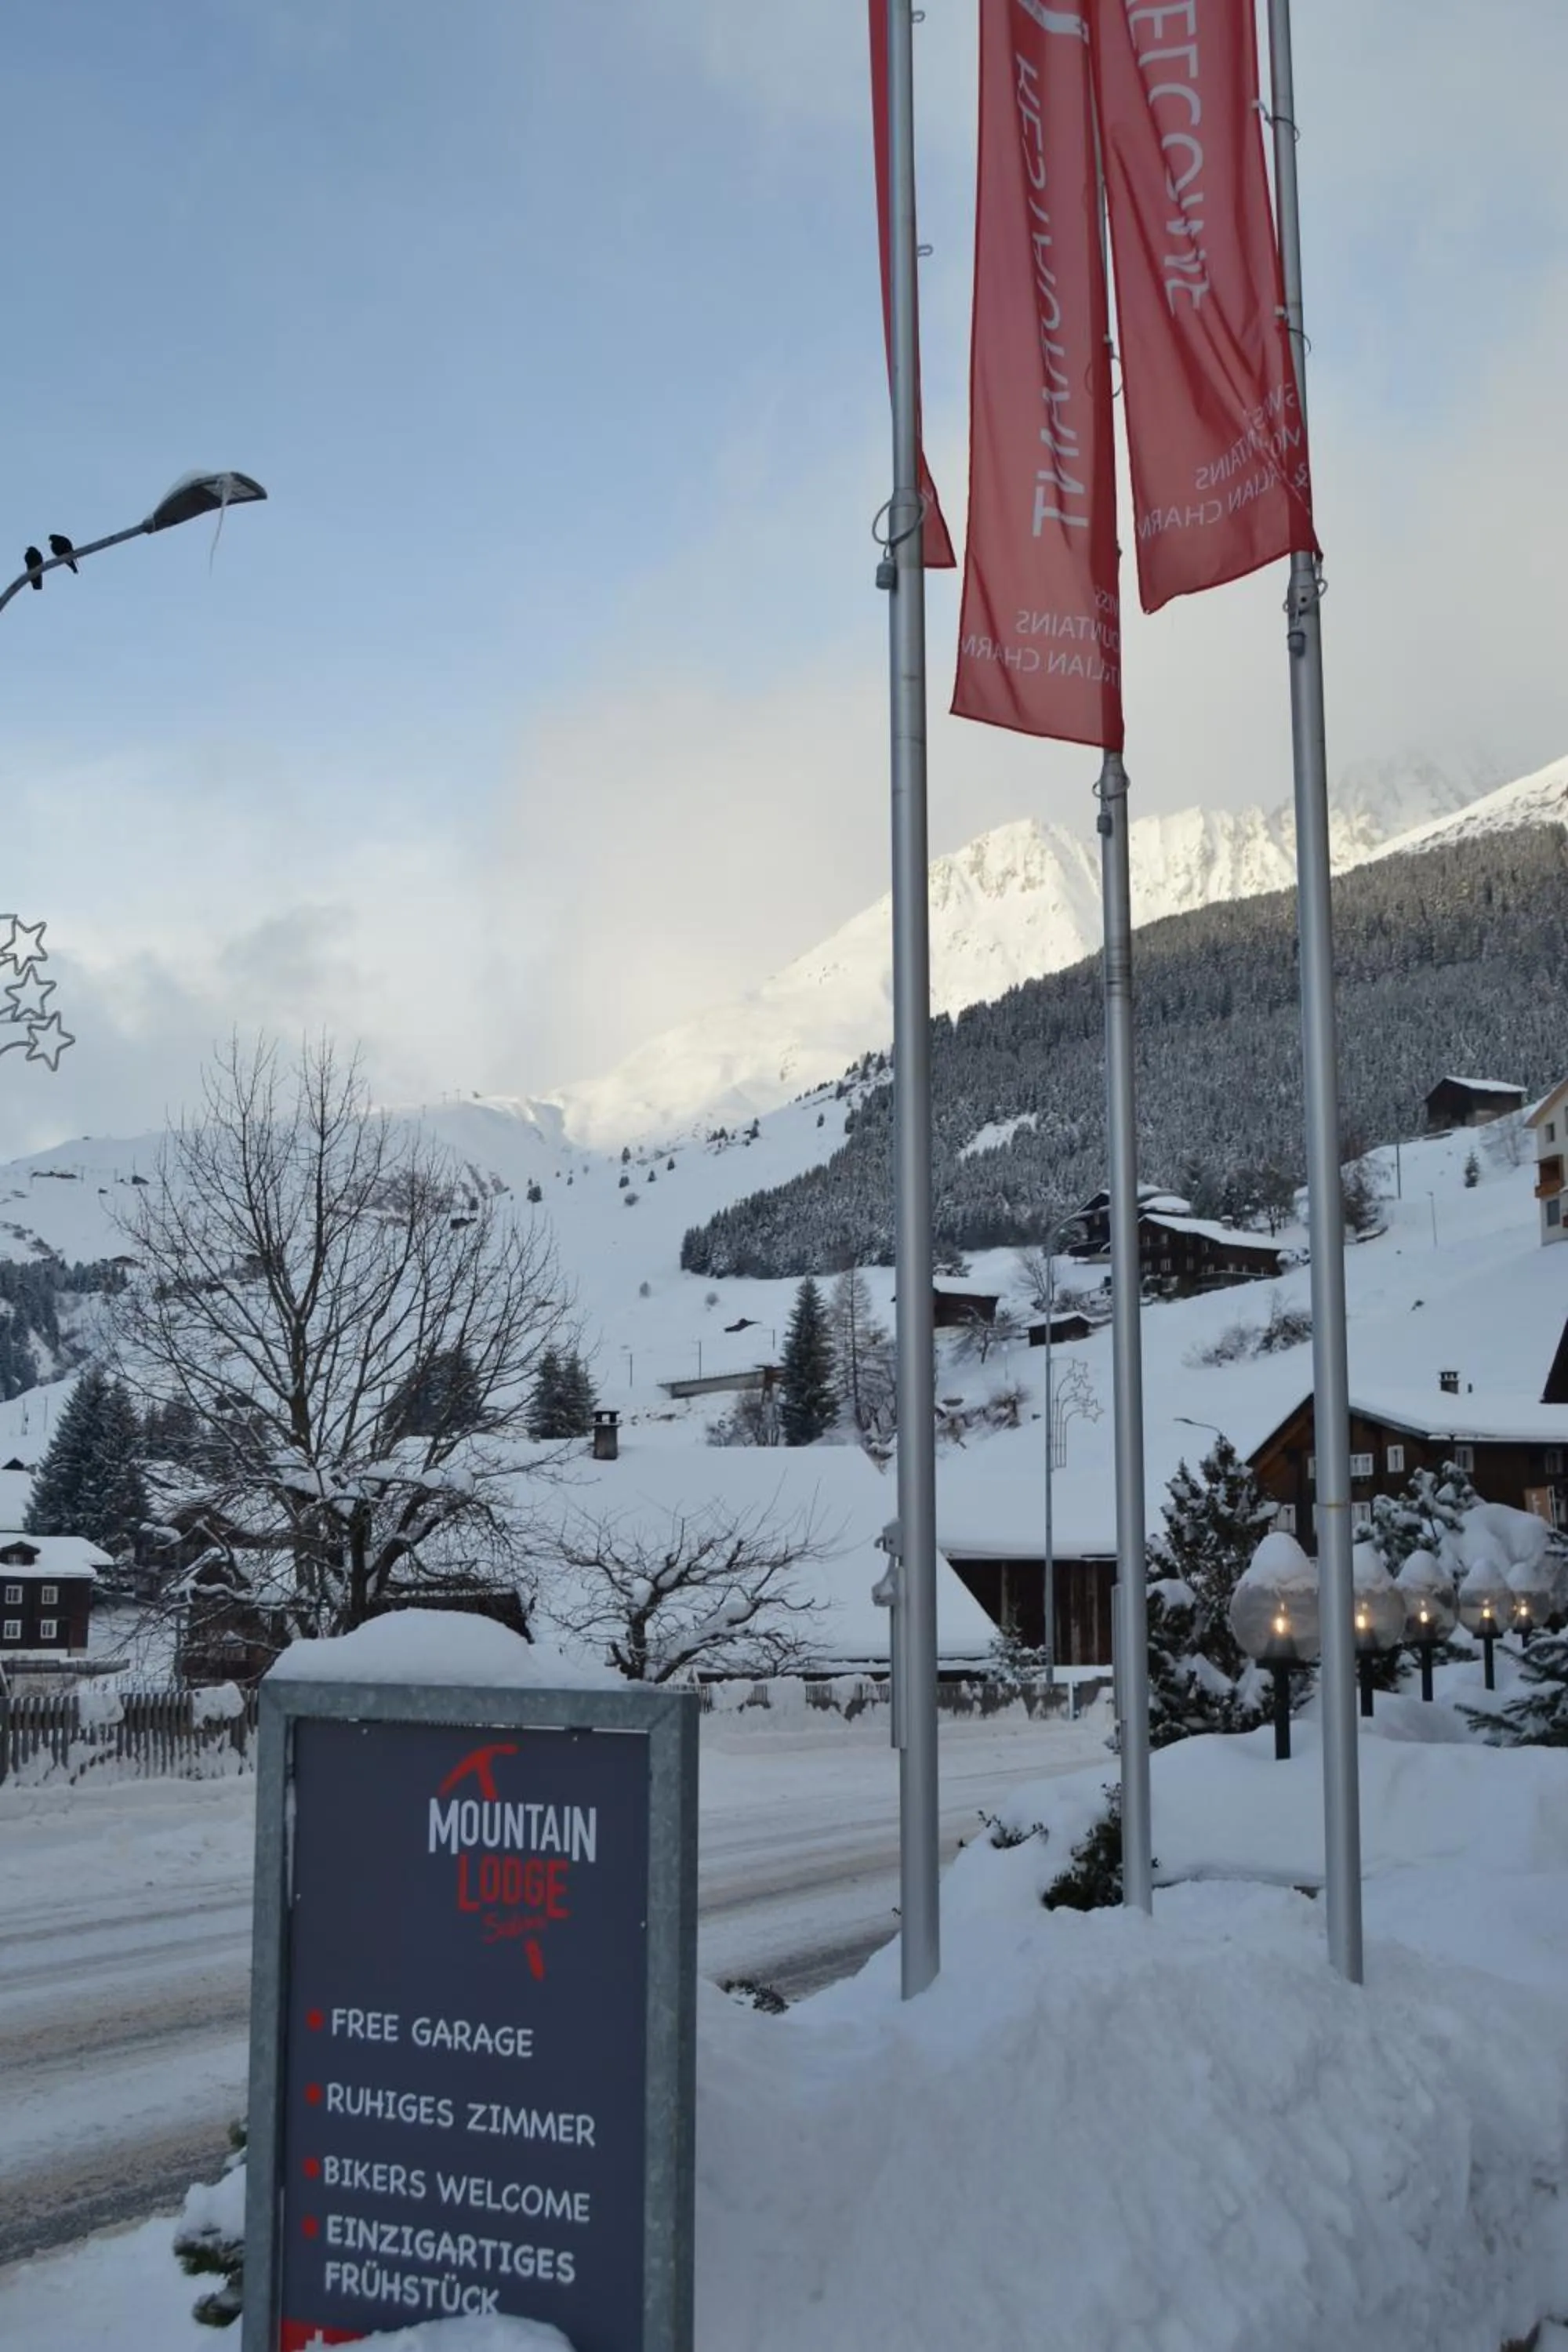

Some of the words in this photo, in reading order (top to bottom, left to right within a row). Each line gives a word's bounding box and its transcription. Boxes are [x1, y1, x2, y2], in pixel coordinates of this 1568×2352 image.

[428, 1797, 597, 1864] MOUNTAIN
[457, 1852, 571, 1919] LODGE
[331, 2008, 399, 2042] FREE
[411, 2017, 533, 2057] GARAGE
[325, 2082, 455, 2128] RUHIGES
[466, 2103, 596, 2148] ZIMMER
[323, 2155, 427, 2198] BIKERS
[436, 2172, 590, 2223] WELCOME
[325, 2214, 576, 2284] EINZIGARTIGES
[325, 2260, 500, 2316] FRÜHSTÜCK
